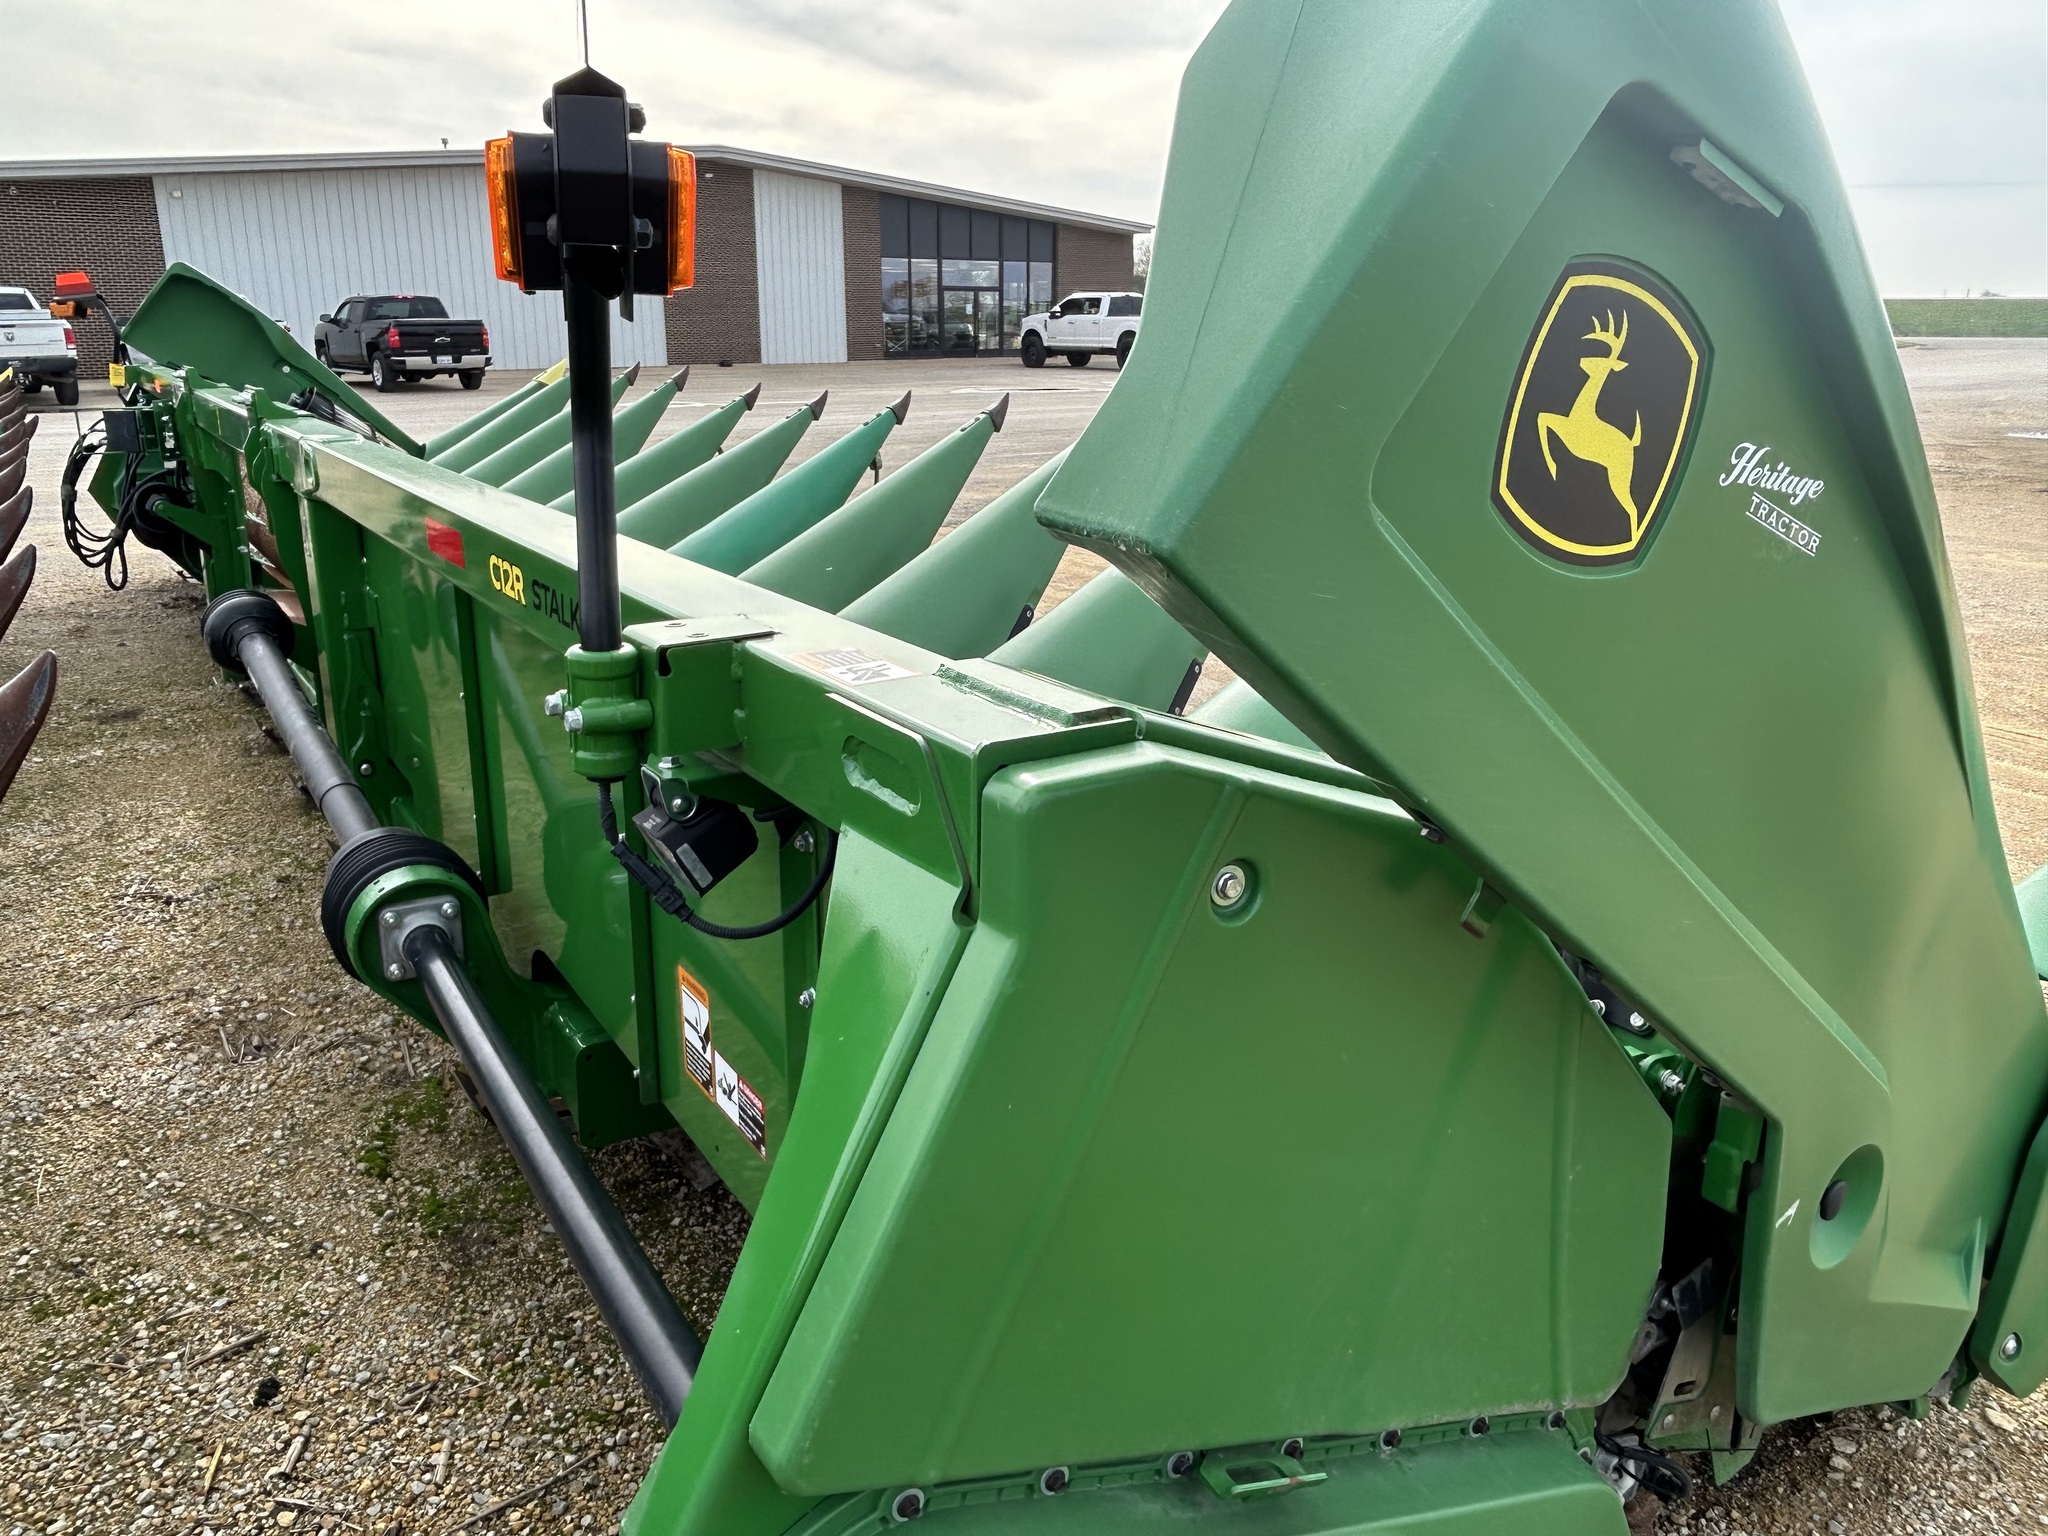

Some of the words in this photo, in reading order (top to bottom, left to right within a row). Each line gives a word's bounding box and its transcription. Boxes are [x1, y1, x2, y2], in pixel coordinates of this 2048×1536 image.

[1719, 442, 1825, 505] Heritage
[1748, 495, 1820, 553] TRACTOR
[489, 554, 527, 606] C12R
